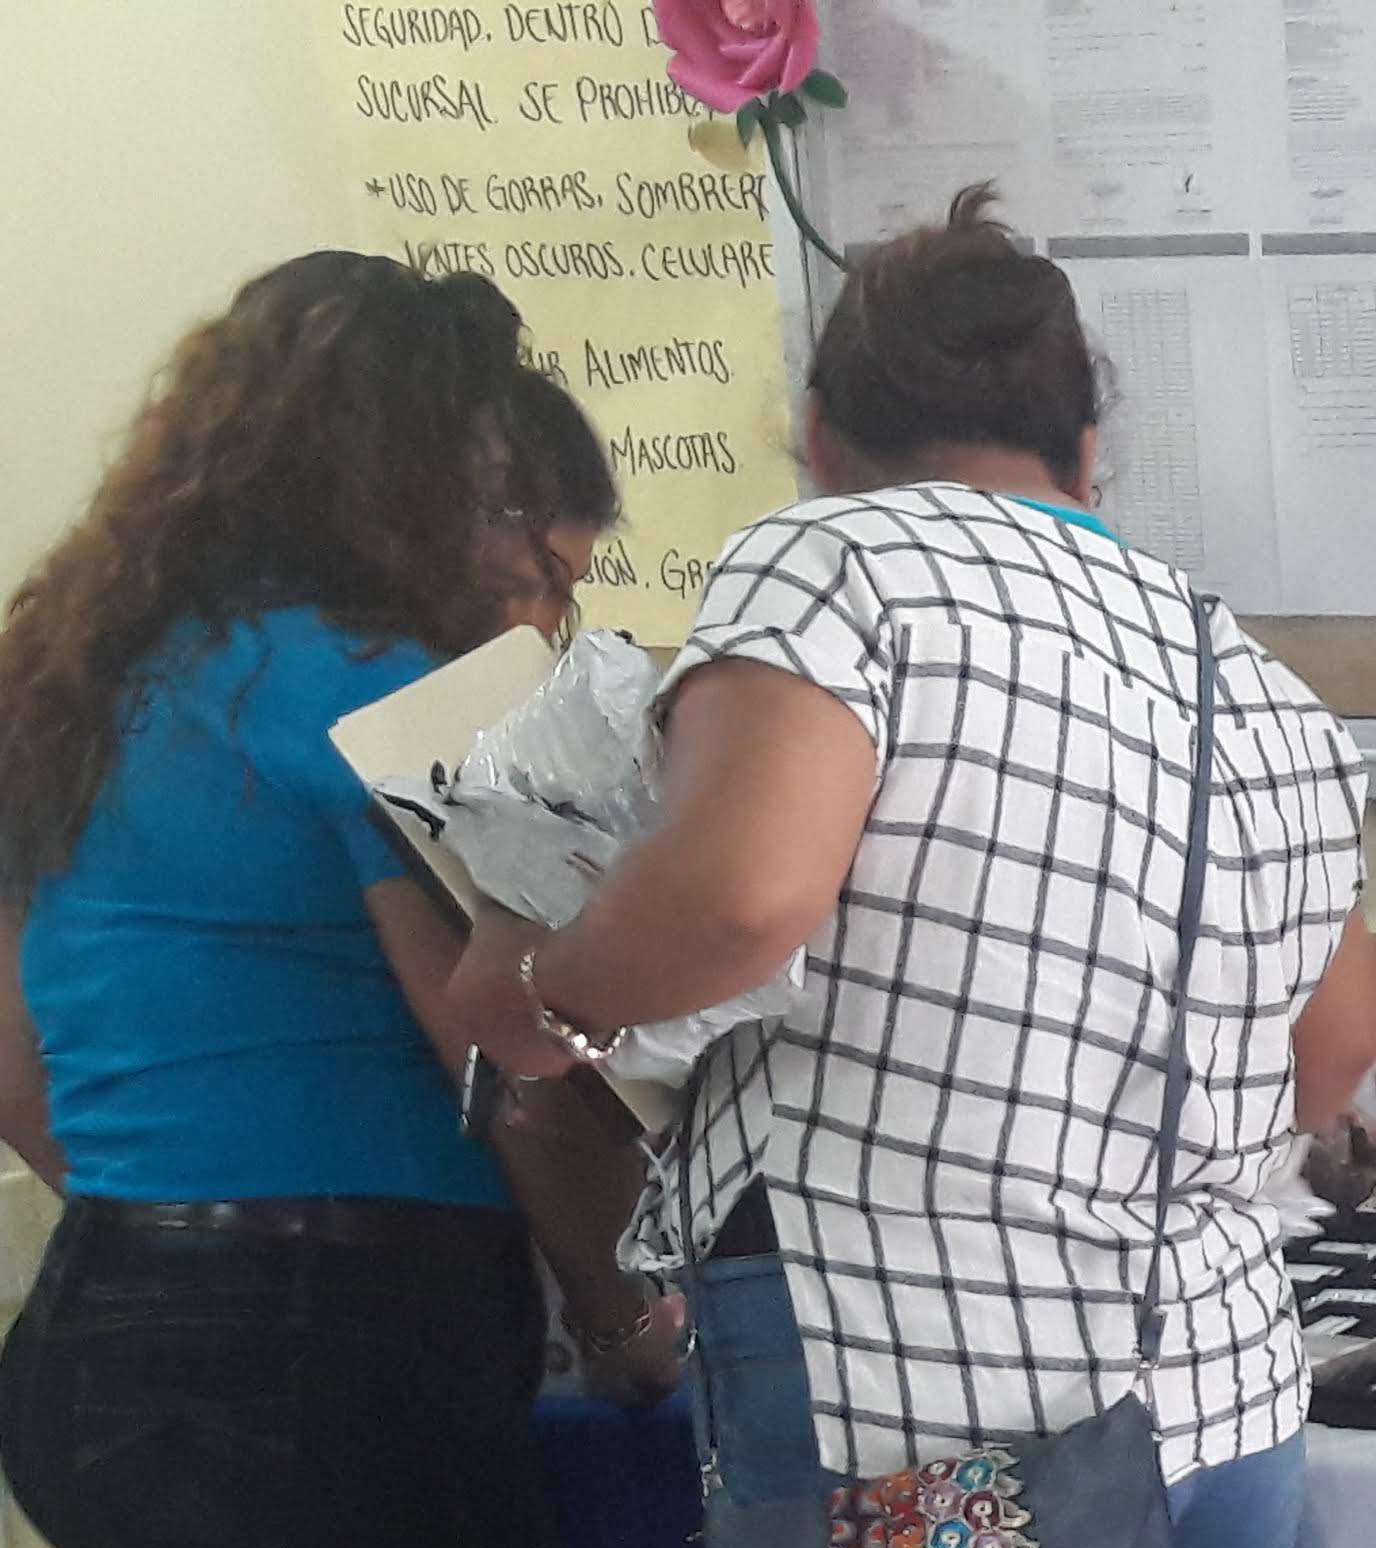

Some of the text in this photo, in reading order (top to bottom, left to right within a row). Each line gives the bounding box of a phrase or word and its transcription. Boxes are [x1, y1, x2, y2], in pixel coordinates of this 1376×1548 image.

[504, 1, 623, 47] DENTRO
[519, 82, 563, 124] SE
[441, 174, 479, 216] DE
